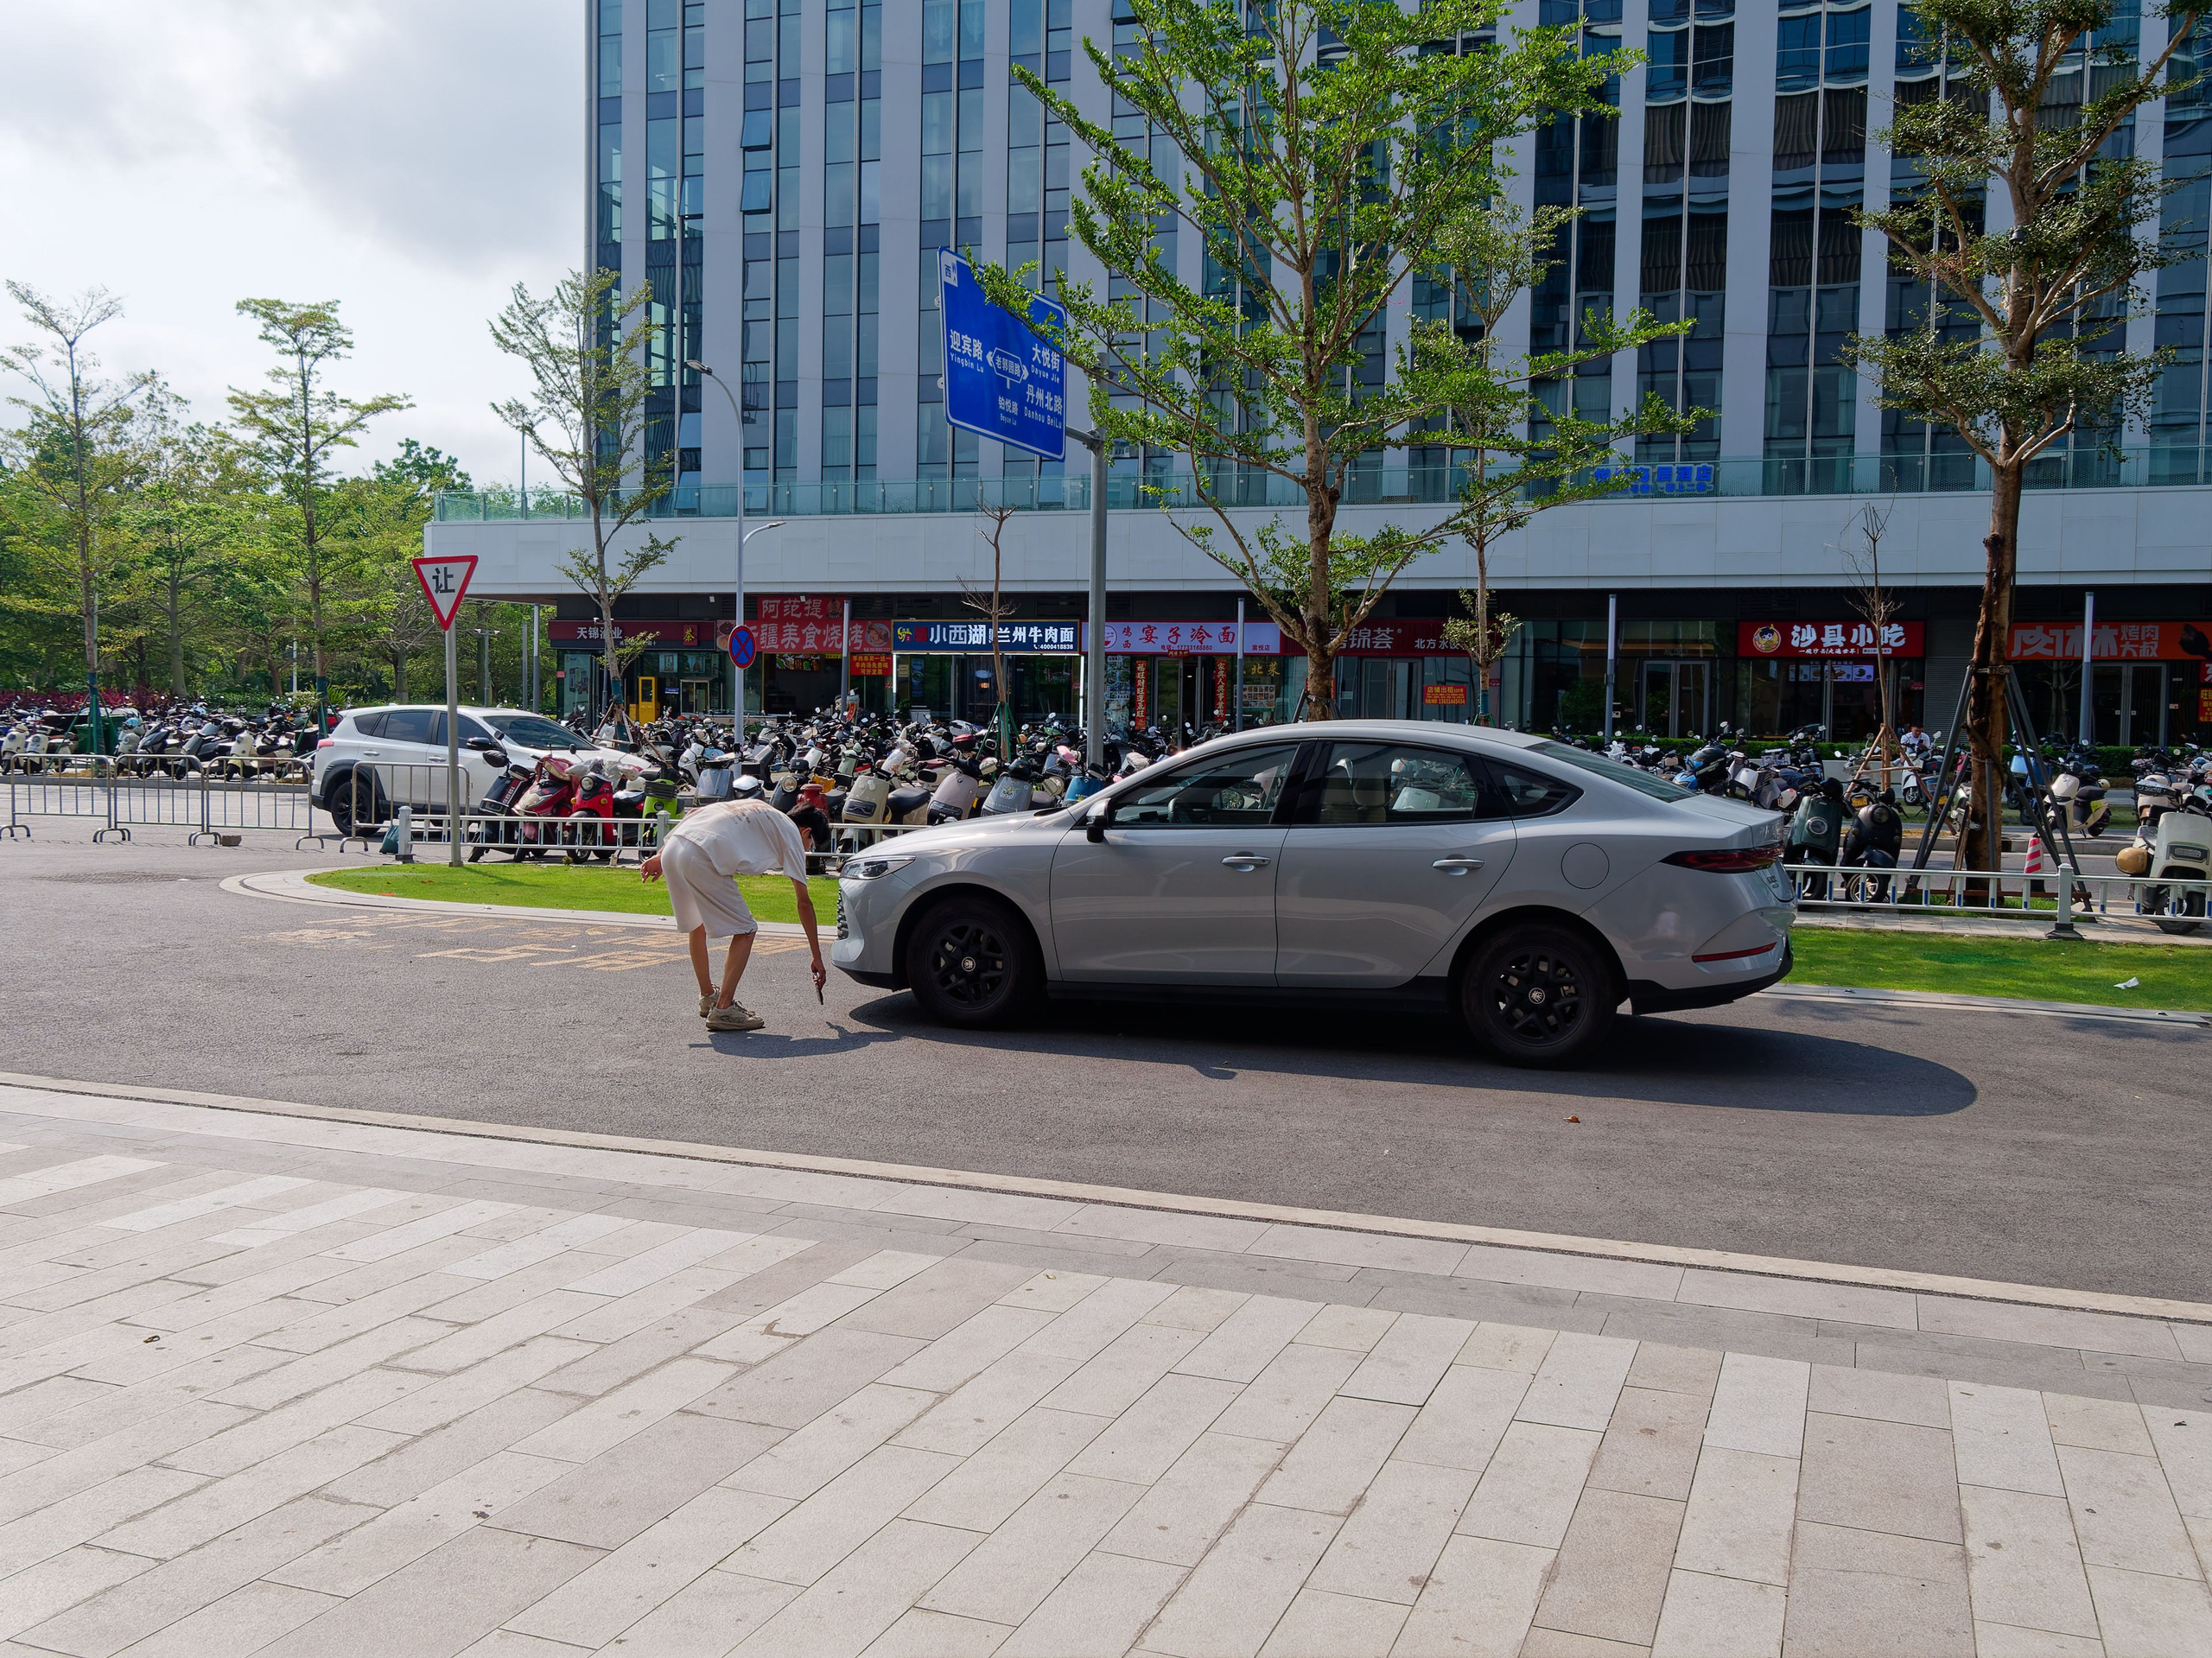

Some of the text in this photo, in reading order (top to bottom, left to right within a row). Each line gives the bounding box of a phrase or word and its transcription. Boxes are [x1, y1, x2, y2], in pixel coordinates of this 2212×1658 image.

[950, 329, 982, 361] 迎宾路
[950, 353, 984, 373] Yingbin Lu
[995, 355, 1020, 377] 老郭园路
[1032, 343, 1060, 372] 大悦街
[1031, 364, 1060, 384] Dayue Jie
[998, 395, 1019, 416] 铂悦路
[1026, 384, 1063, 416] 丹州北路
[432, 567, 455, 594] 让
[683, 627, 695, 642] 茶
[930, 624, 986, 645] 小西湖
[997, 626, 1074, 643] 兰州牛肉面
[1790, 624, 1906, 648] 沙县小吃
[2120, 625, 2159, 640] 烤肉
[2120, 642, 2158, 657] 大叔
